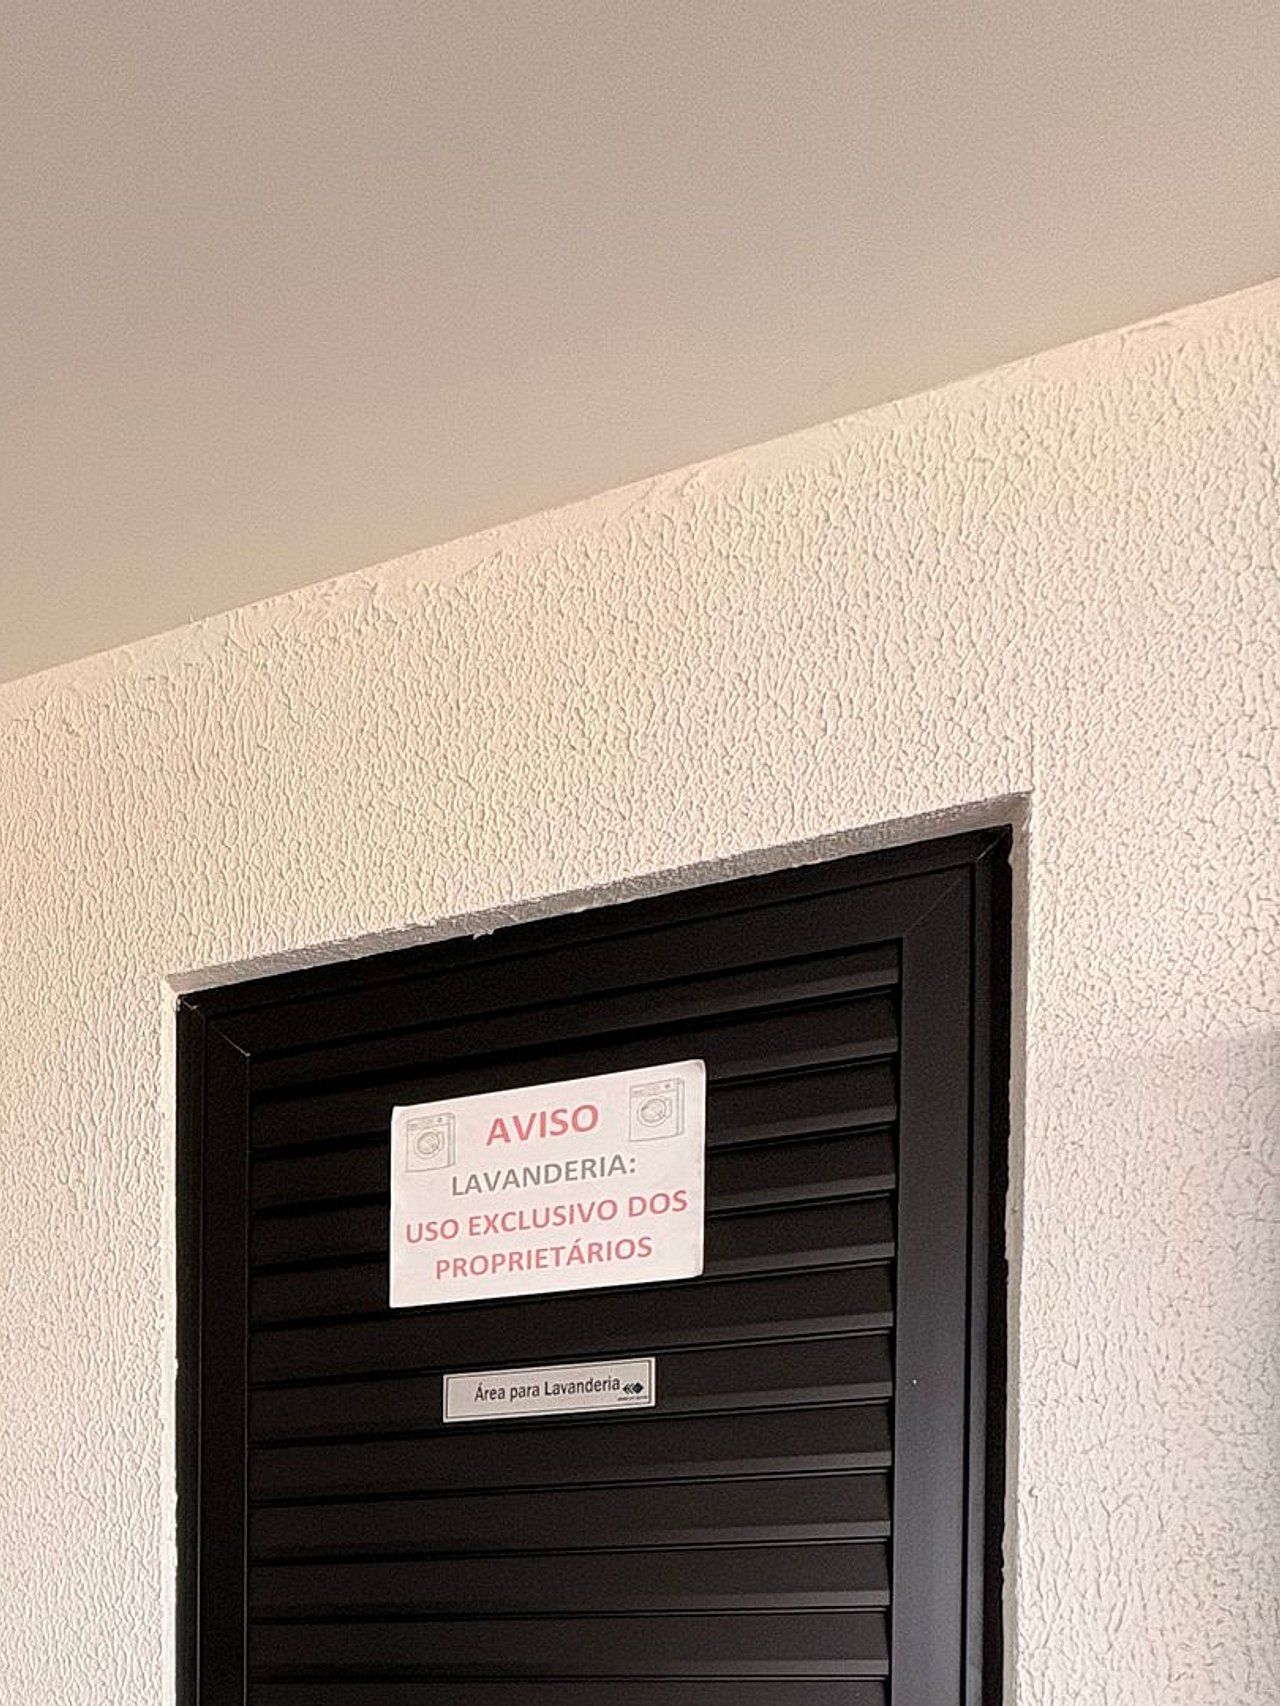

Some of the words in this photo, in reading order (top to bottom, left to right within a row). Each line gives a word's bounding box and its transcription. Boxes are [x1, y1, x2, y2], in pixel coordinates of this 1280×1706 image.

[486, 1104, 599, 1147] AVISO
[451, 1154, 636, 1197] LAVANDERIA:
[406, 1218, 459, 1245] USO
[469, 1199, 617, 1237] EXCLUSIVO
[628, 1190, 688, 1218] DOS
[435, 1236, 653, 1280] PROPRIETÁRIOS
[474, 1382, 506, 1402] Área
[510, 1384, 540, 1402] para
[544, 1376, 621, 1396] Lavanderia
